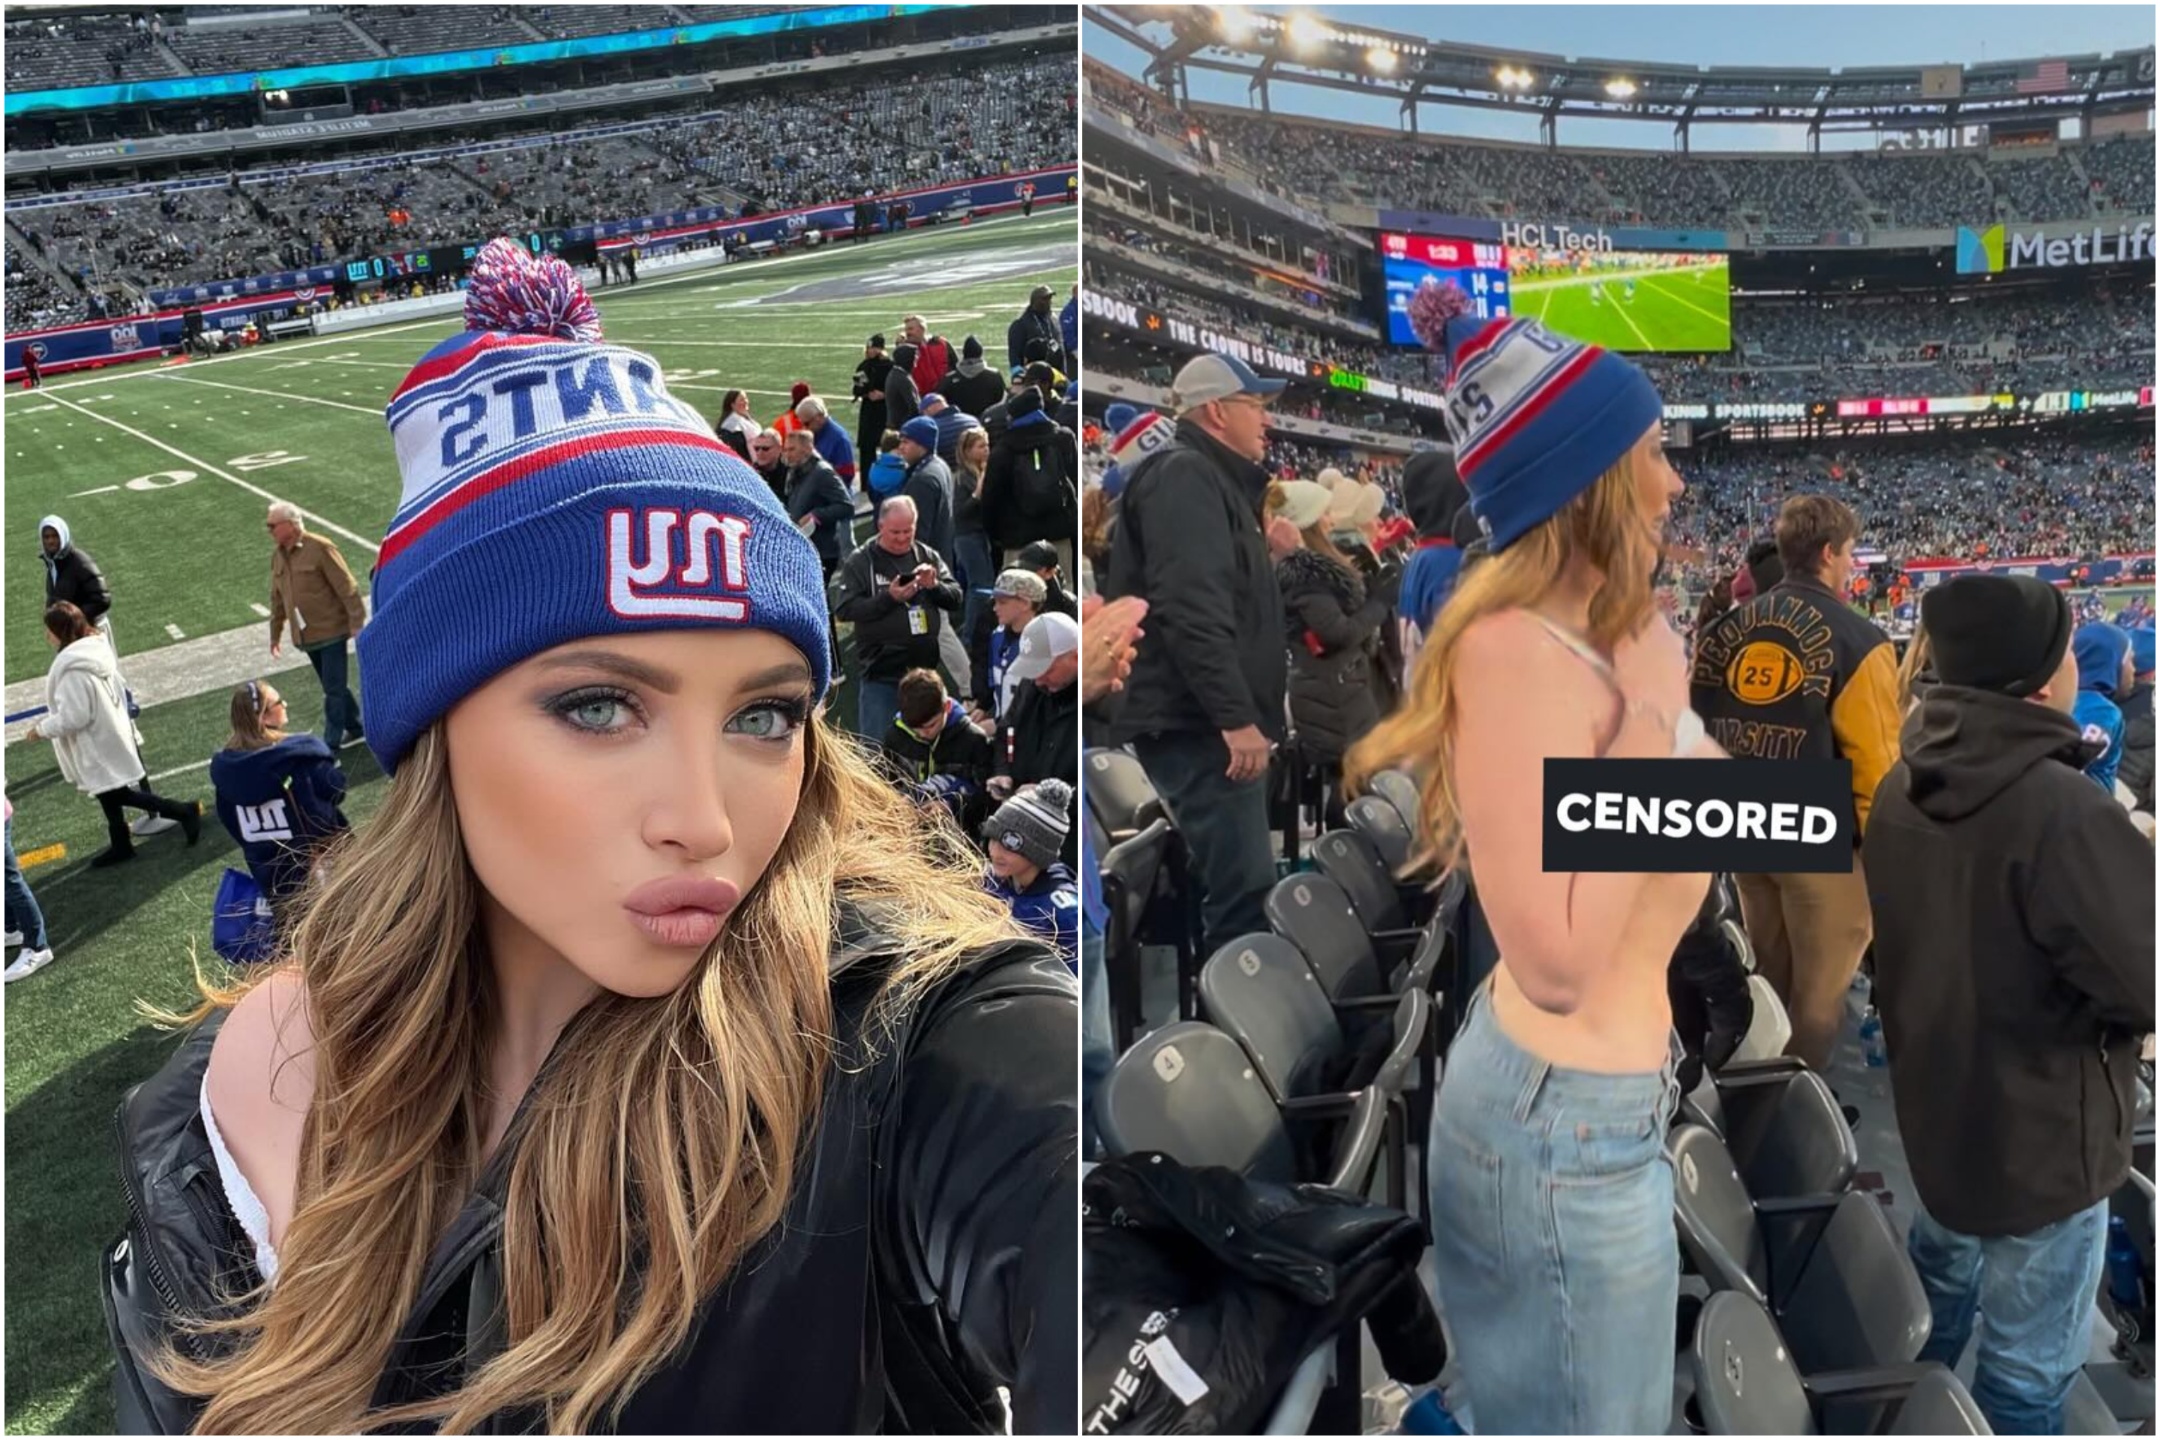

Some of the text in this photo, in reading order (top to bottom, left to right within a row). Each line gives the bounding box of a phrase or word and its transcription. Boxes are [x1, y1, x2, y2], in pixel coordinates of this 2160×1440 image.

[1502, 221, 1613, 251] HCLTech
[1471, 272, 1488, 296] 14
[1082, 290, 1139, 329] SBOOK
[1167, 318, 1197, 346] THE
[1199, 326, 1249, 359] CROWN
[1252, 343, 1265, 365] IS
[1267, 348, 1307, 376] YOURS
[1715, 403, 1806, 419] SPORTSBOOK
[1744, 666, 1773, 686] 25
[1711, 717, 1807, 759] ARSITY
[1088, 1367, 1141, 1436] THE
